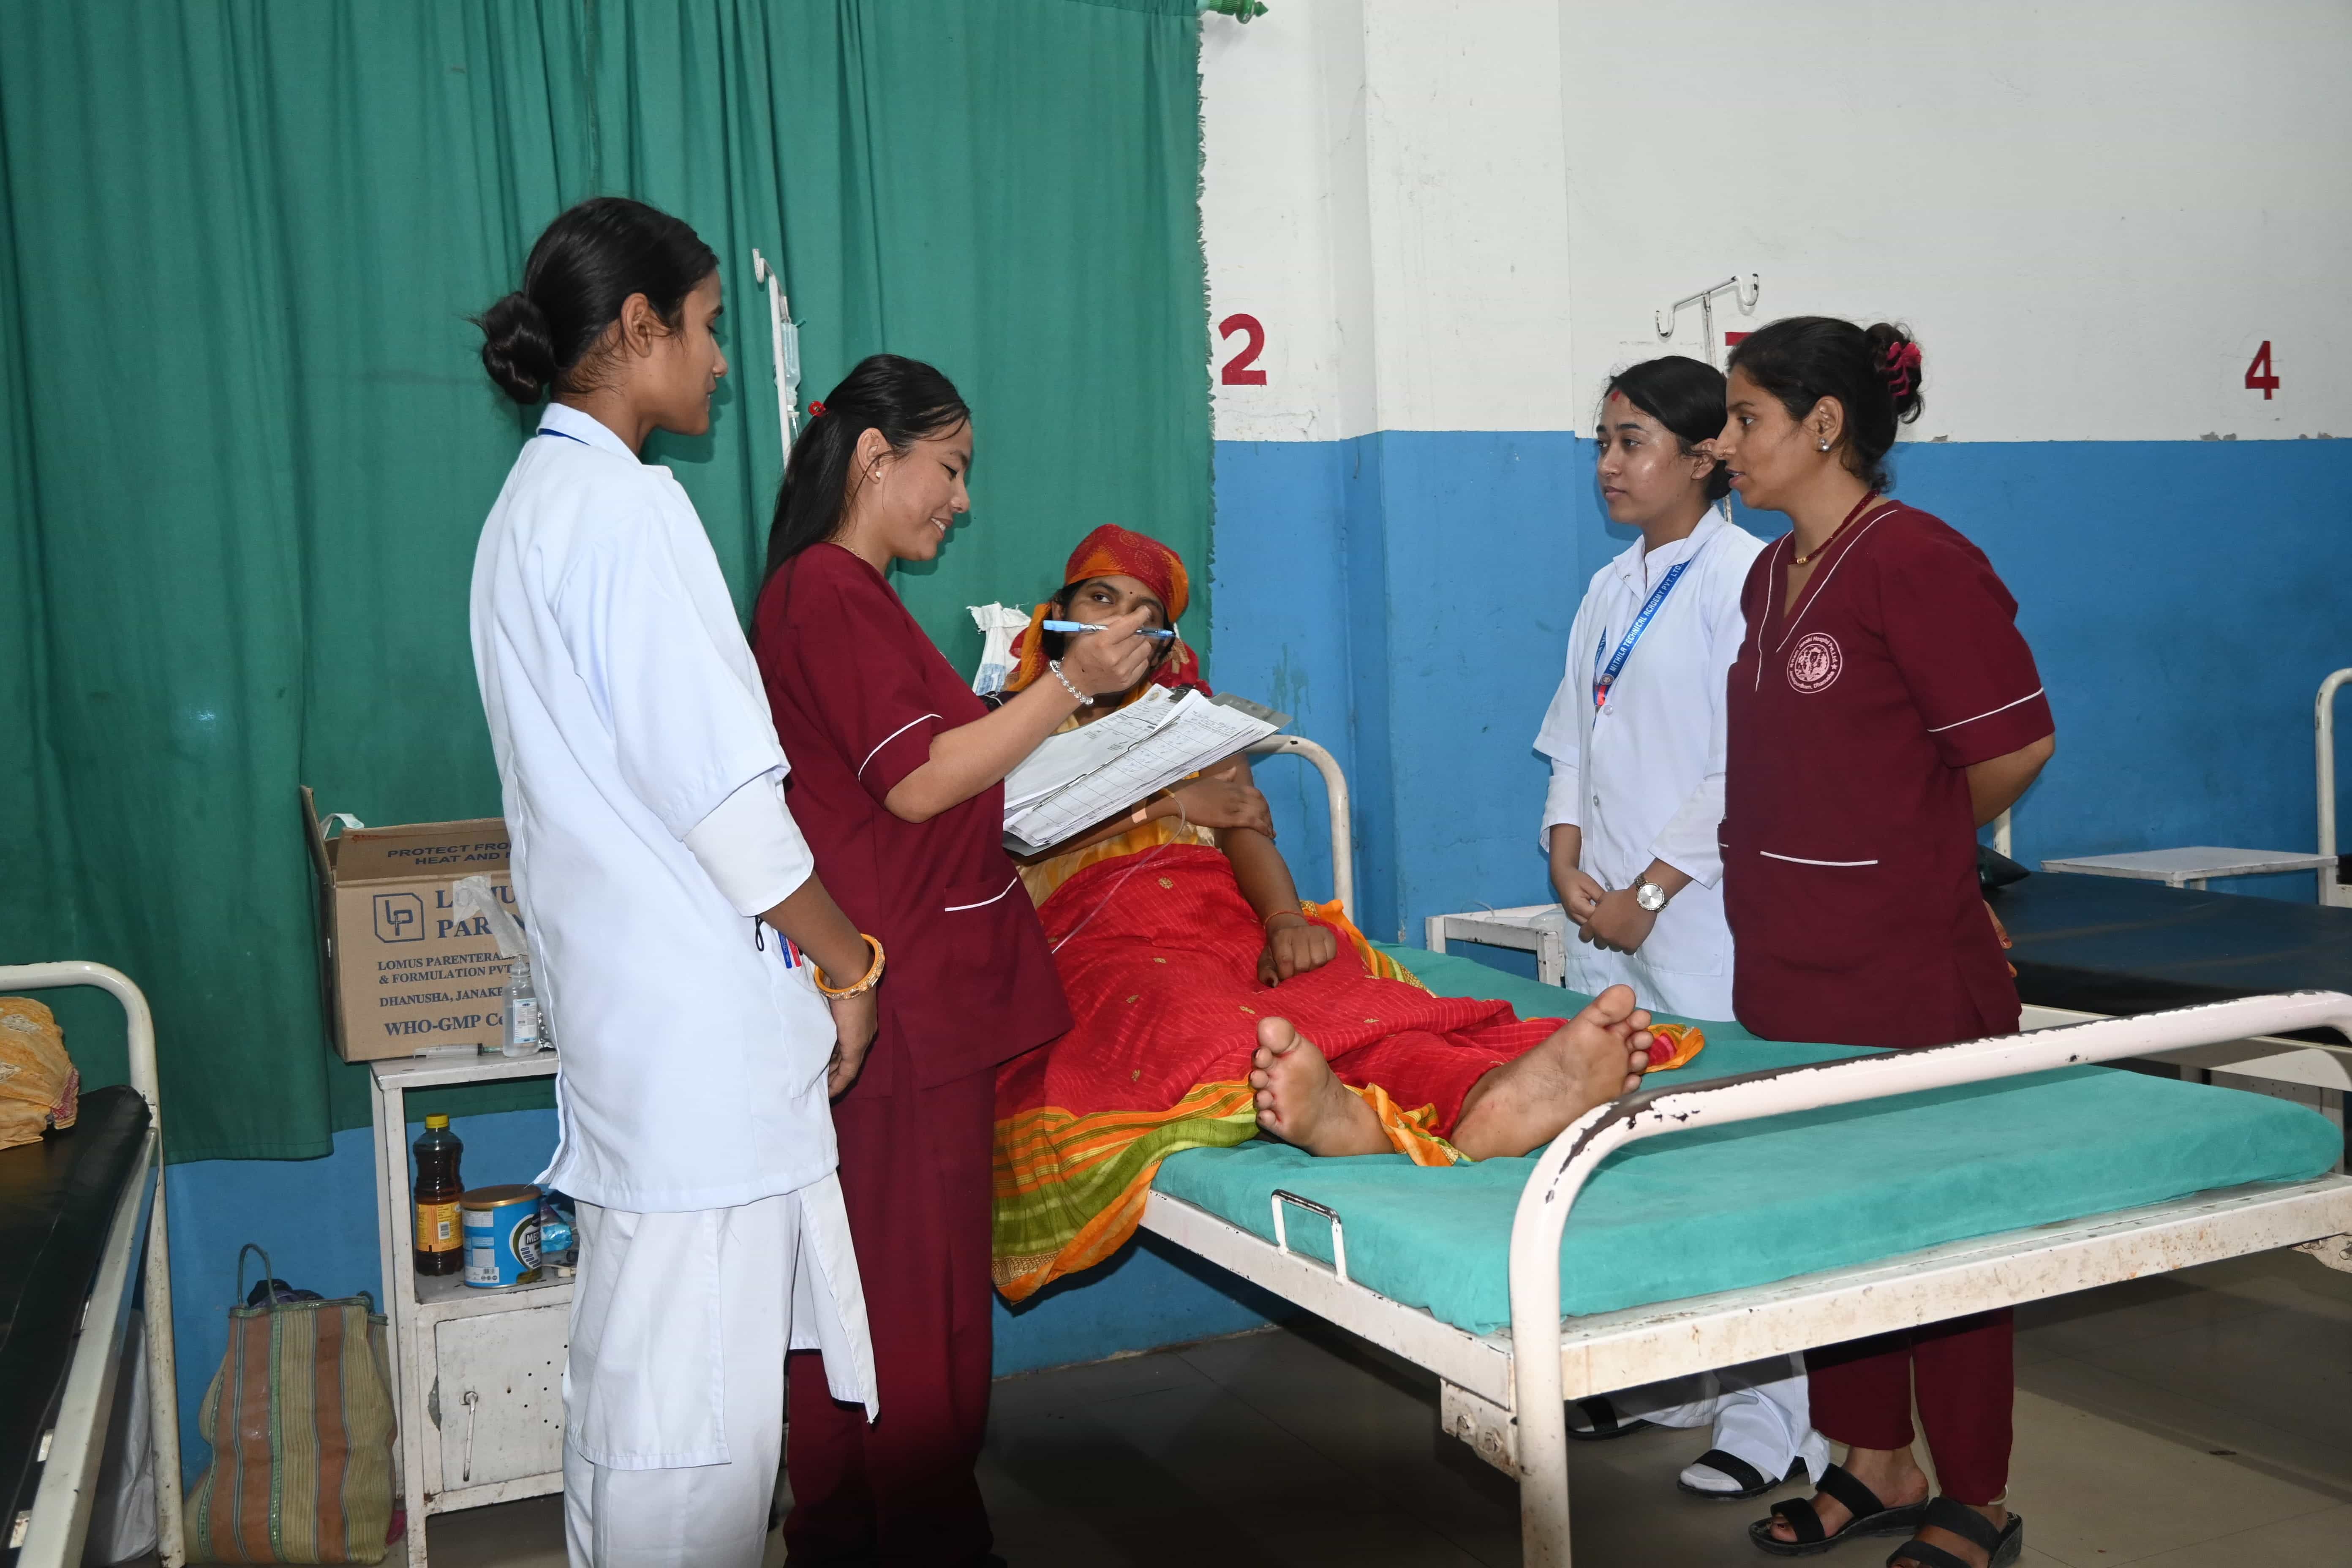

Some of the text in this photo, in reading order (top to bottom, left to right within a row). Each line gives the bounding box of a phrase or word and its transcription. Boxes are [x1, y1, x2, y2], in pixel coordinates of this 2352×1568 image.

[1218, 313, 1267, 385] 2
[2245, 340, 2279, 400] 4
[1609, 647, 1627, 672] MITHILA
[1623, 616, 1647, 647] TECHNICAL
[1643, 590, 1664, 616] ACADEMY
[387, 842, 512, 858] PROTECT FRO
[415, 855, 461, 865] HEAT
[463, 852, 500, 862] AND
[378, 952, 516, 971] LOMUS PARENTERA
[379, 975, 389, 984] &
[392, 966, 486, 983] FORMULATION
[379, 993, 453, 1007] DHANUSHA,
[384, 1015, 481, 1036] WHO-GMP
